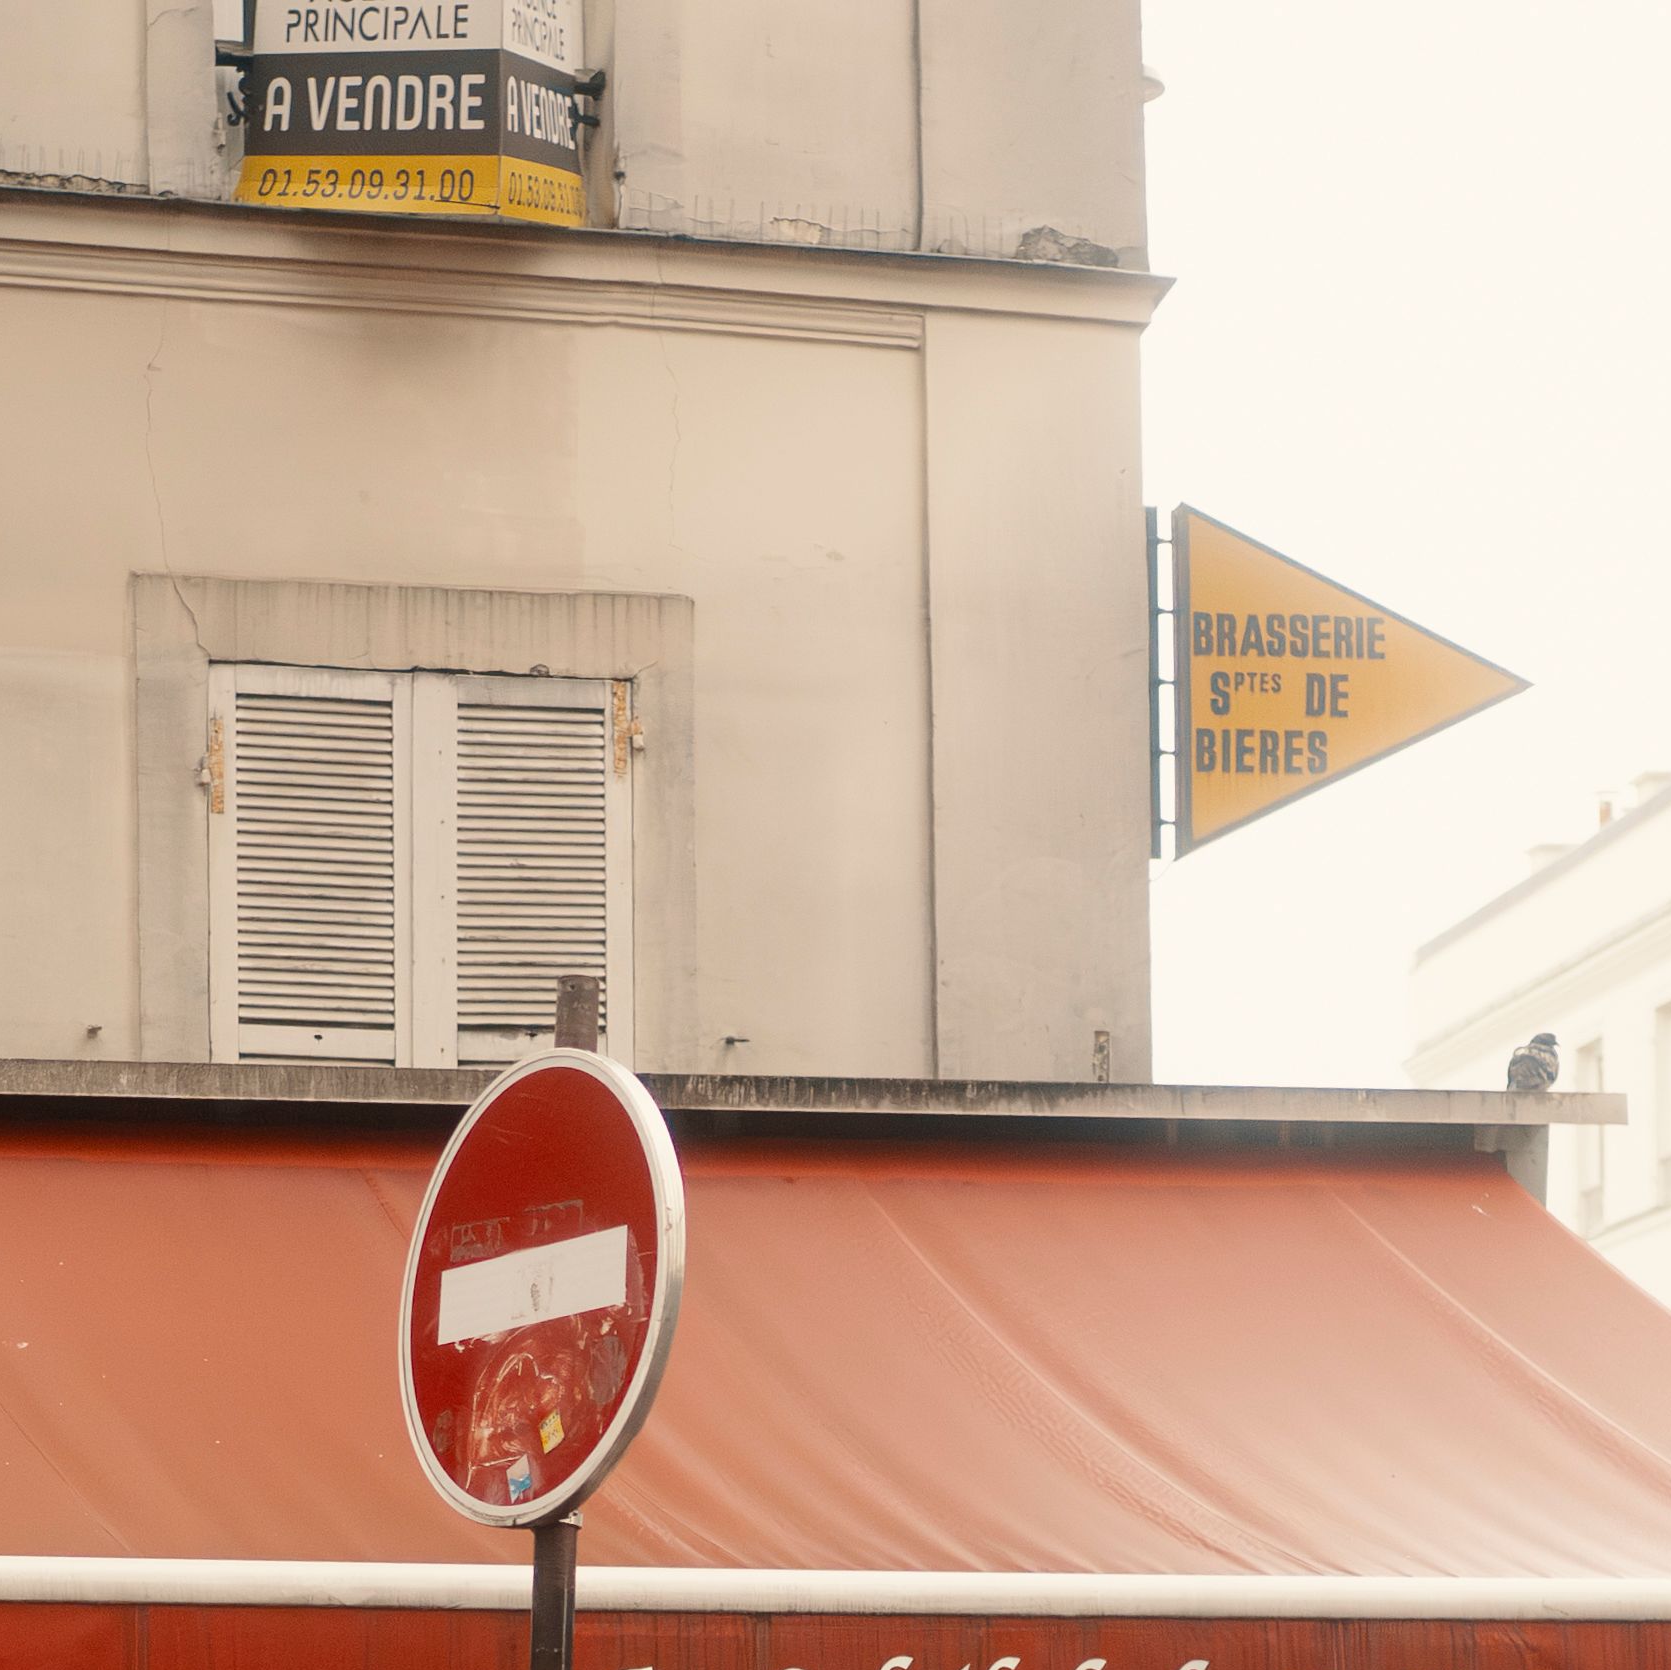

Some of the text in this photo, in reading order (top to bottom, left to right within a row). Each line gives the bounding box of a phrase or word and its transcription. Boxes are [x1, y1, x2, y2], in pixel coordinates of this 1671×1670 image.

[286, 5, 469, 43] PRINCIPALE
[263, 73, 486, 132] A VENDRE
[506, 75, 576, 151] A VENDRE
[257, 167, 475, 202] 01.53.09.31.00
[1192, 611, 1386, 660] BRASSERIE
[1304, 672, 1350, 719] DE
[1195, 728, 1329, 776] BIERES
